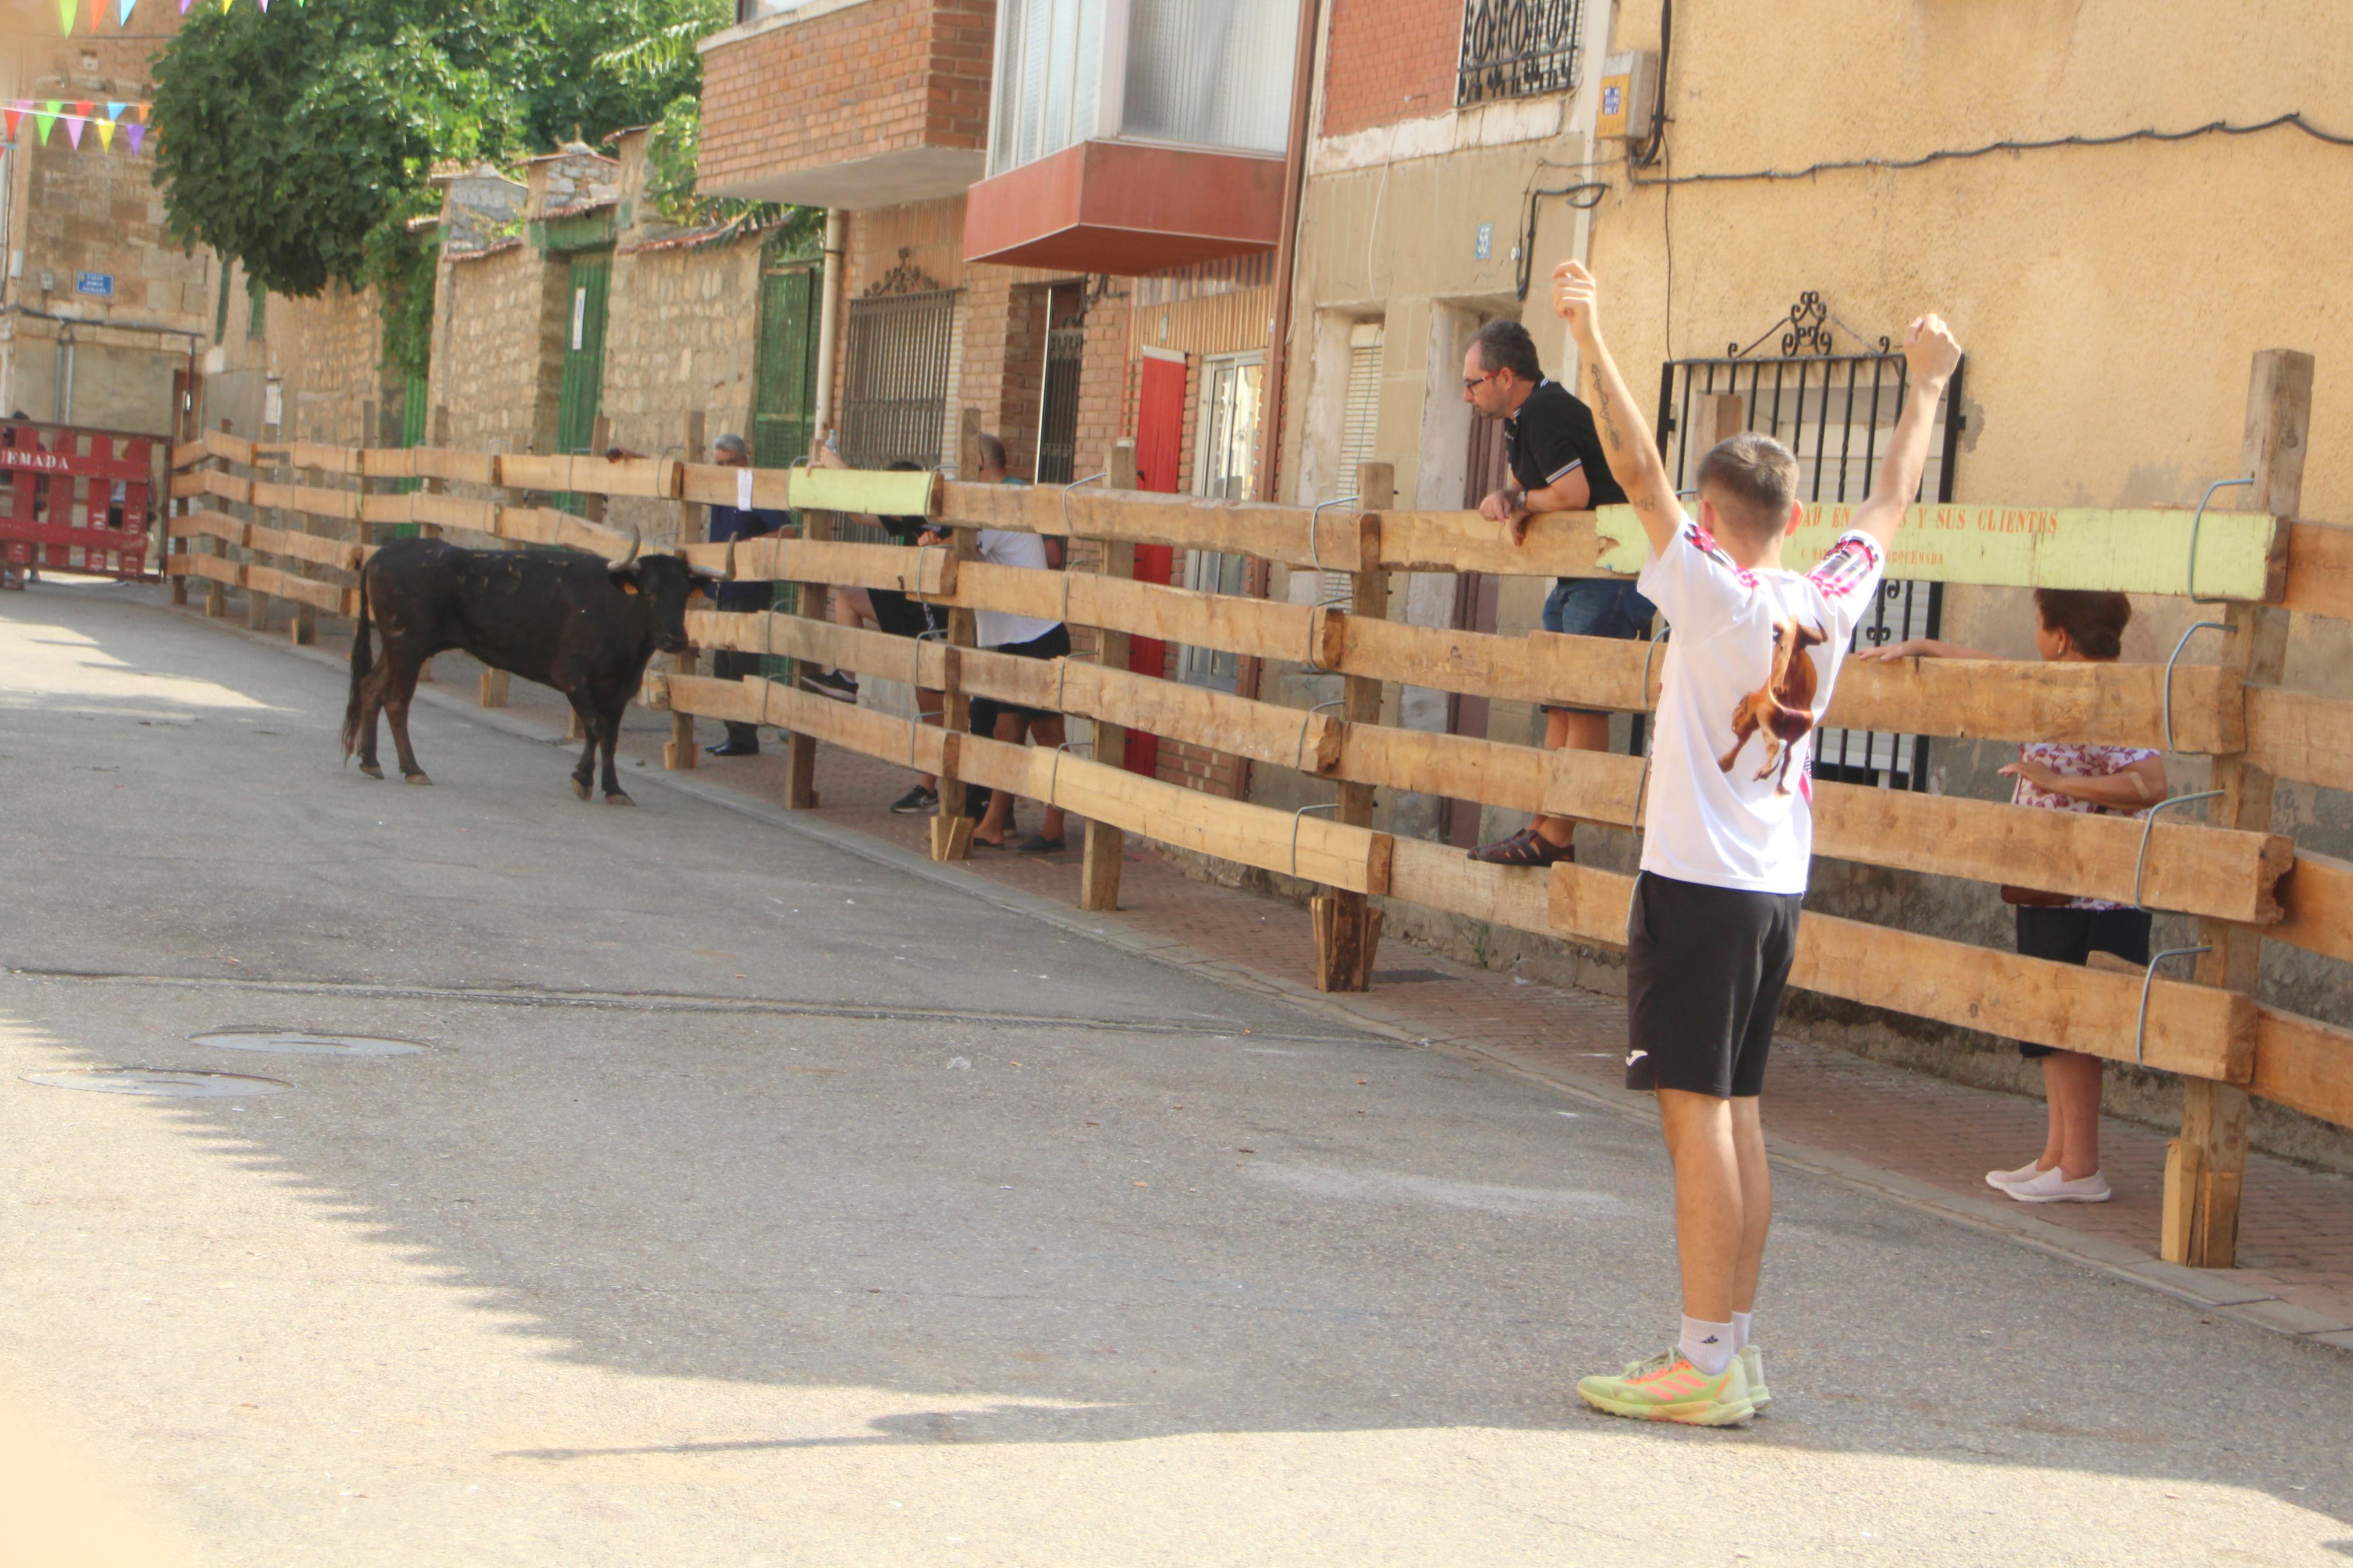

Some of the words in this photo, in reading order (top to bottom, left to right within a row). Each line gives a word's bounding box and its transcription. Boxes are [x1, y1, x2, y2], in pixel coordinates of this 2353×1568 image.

[1918, 507, 1928, 529] Y
[1936, 507, 1966, 530] SUS
[1977, 508, 2059, 534] CLIENTES
